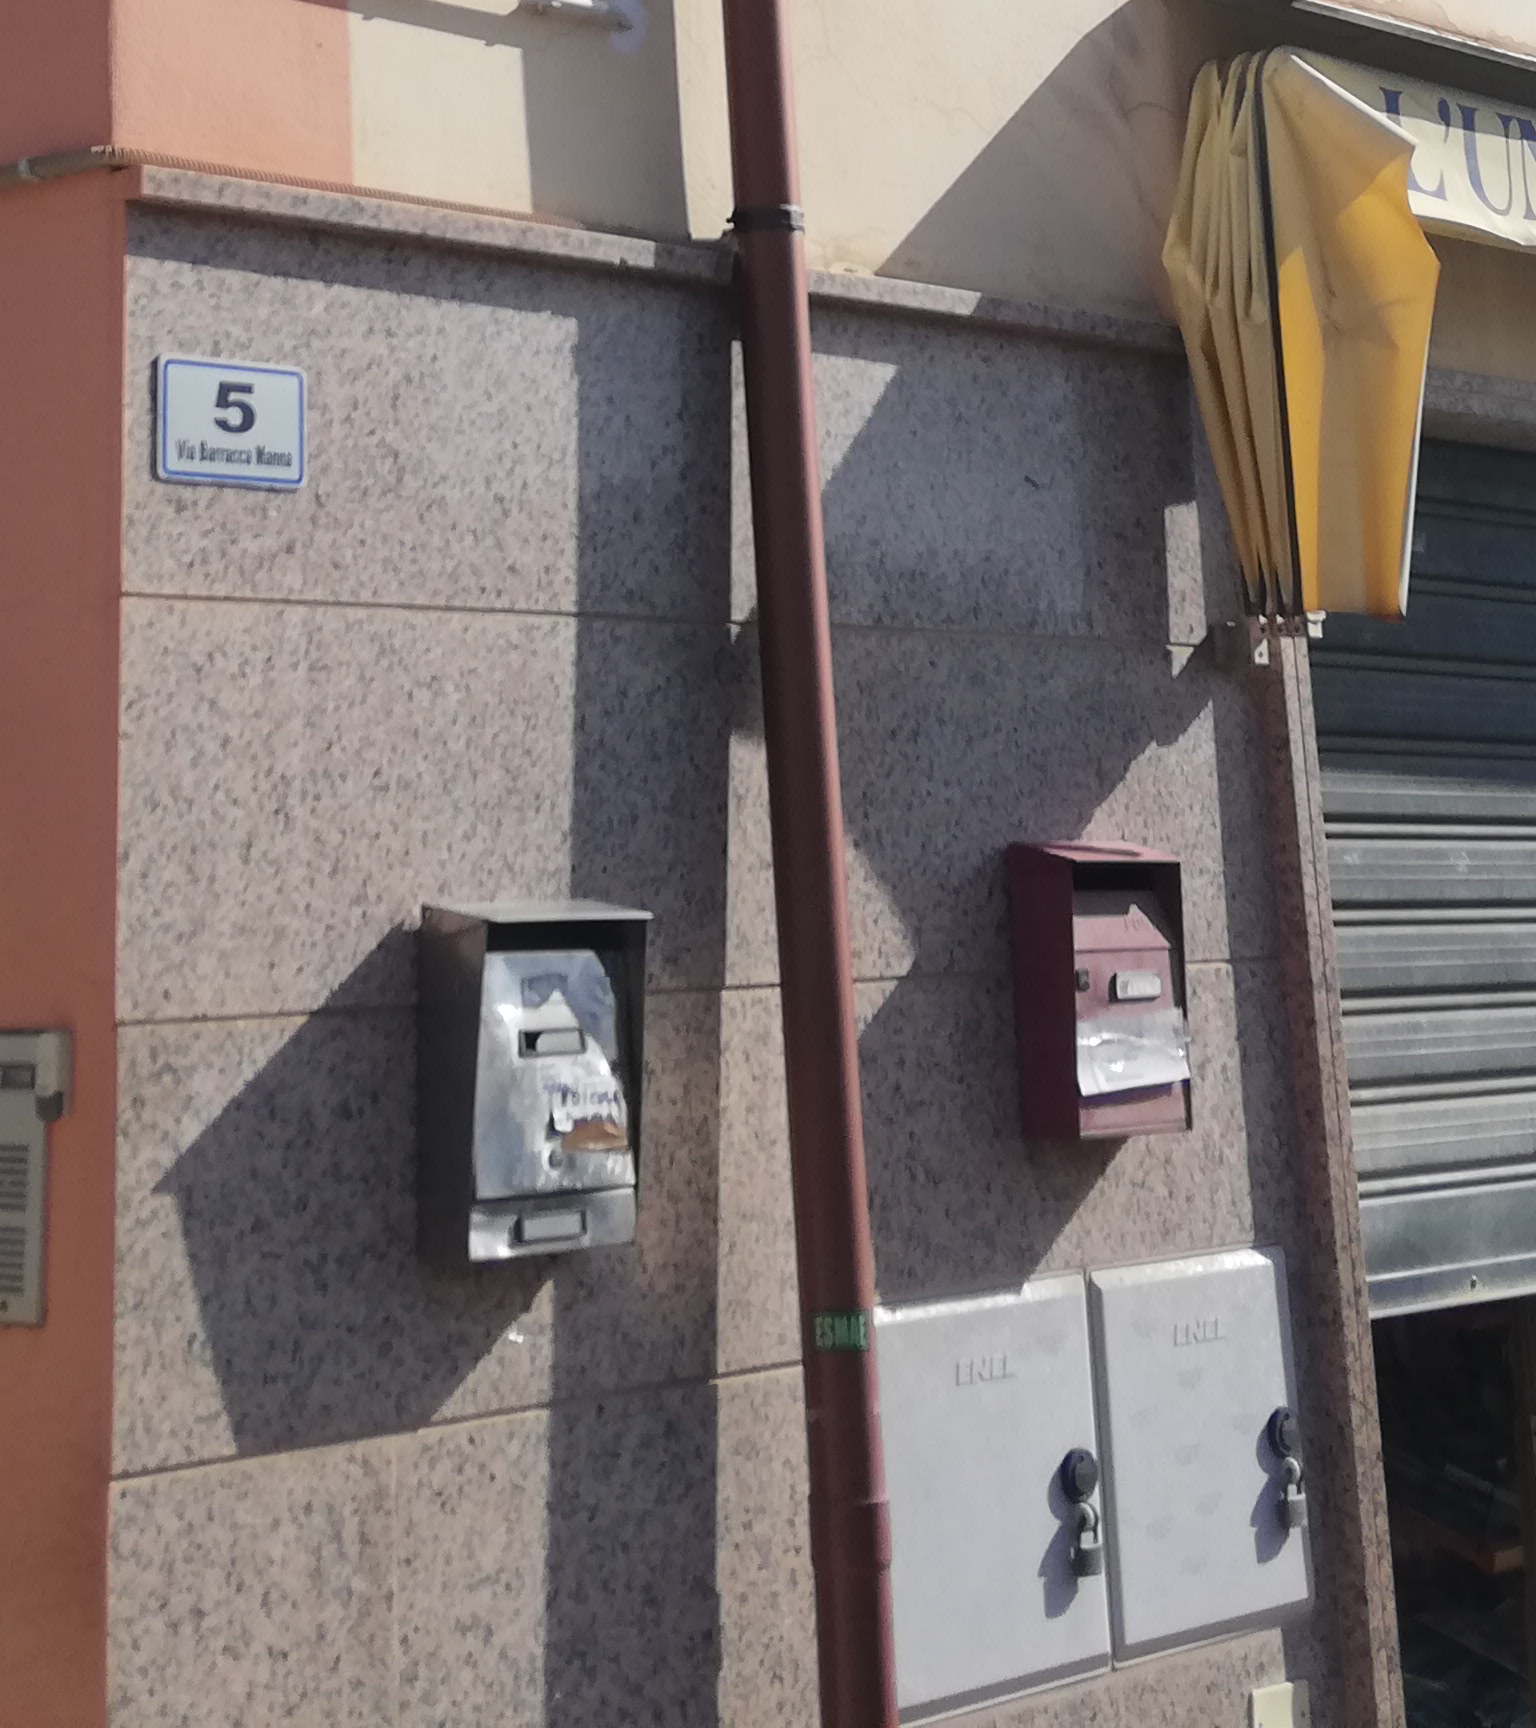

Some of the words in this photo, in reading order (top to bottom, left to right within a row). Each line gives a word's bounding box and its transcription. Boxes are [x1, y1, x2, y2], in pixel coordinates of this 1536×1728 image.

[214, 380, 256, 434] 5
[175, 438, 196, 462] Via
[1173, 1314, 1228, 1348] ENEL
[954, 1353, 1017, 1387] ENEL
